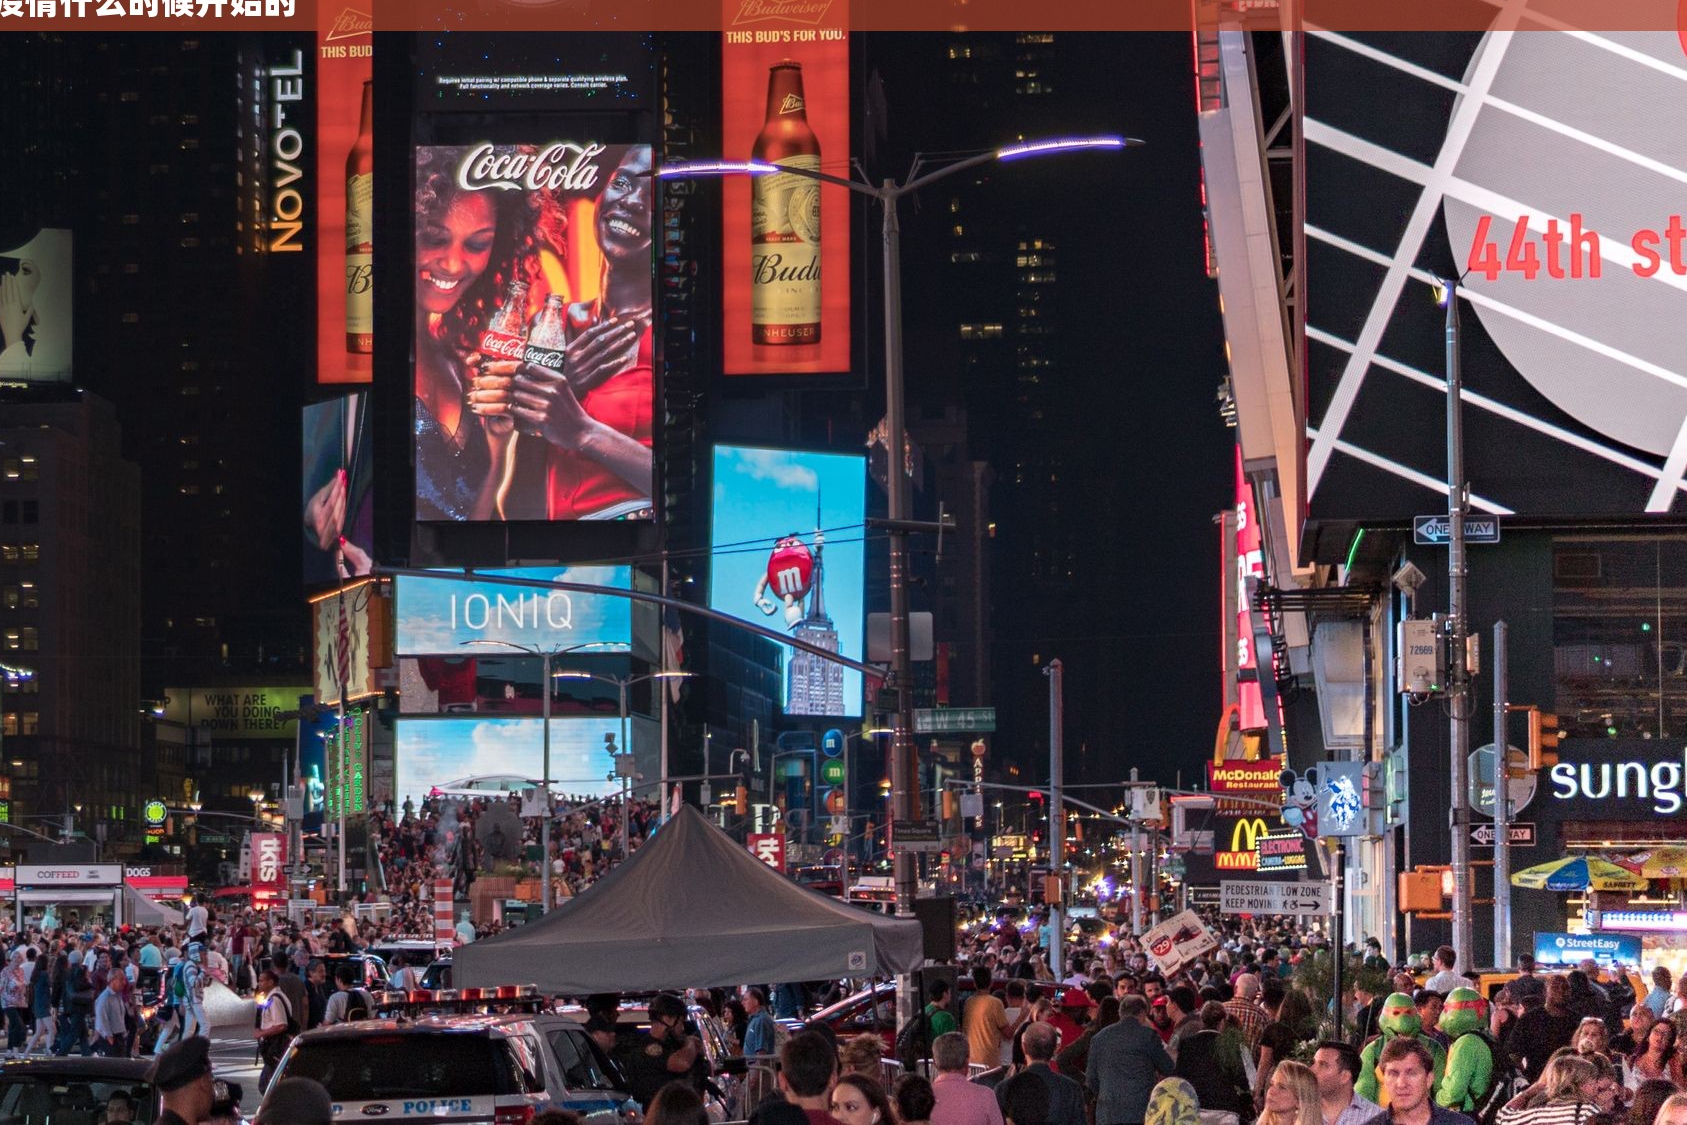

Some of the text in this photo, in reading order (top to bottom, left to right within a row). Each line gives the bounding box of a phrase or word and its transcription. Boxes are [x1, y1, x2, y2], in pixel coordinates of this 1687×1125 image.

[727, 28, 846, 44] THIS BUD'S FOR YOU.
[321, 46, 346, 59] THIS
[270, 49, 303, 253] NOVOTEL
[459, 140, 607, 192] Coca-Cola
[1467, 213, 1602, 281] 44th
[1426, 523, 1490, 535] ONE WAY
[778, 566, 801, 595] m
[450, 592, 573, 630] IONIQ
[1410, 644, 1433, 655] 72669
[205, 694, 266, 706] WHAT ARE
[215, 706, 239, 718] YOU
[201, 718, 239, 730] DOWN
[936, 710, 949, 729] W
[956, 711, 975, 729] 45
[1226, 781, 1278, 789] Restaurant
[260, 837, 281, 883] tkts
[37, 871, 79, 879] COFFEED
[125, 867, 151, 877] DOGS
[1301, 886, 1322, 897] ZONE
[1225, 898, 1245, 909] KEEP
[1153, 939, 1171, 955] $29
[1566, 937, 1621, 951] StreetEasy
[403, 1098, 472, 1115] POLICE
